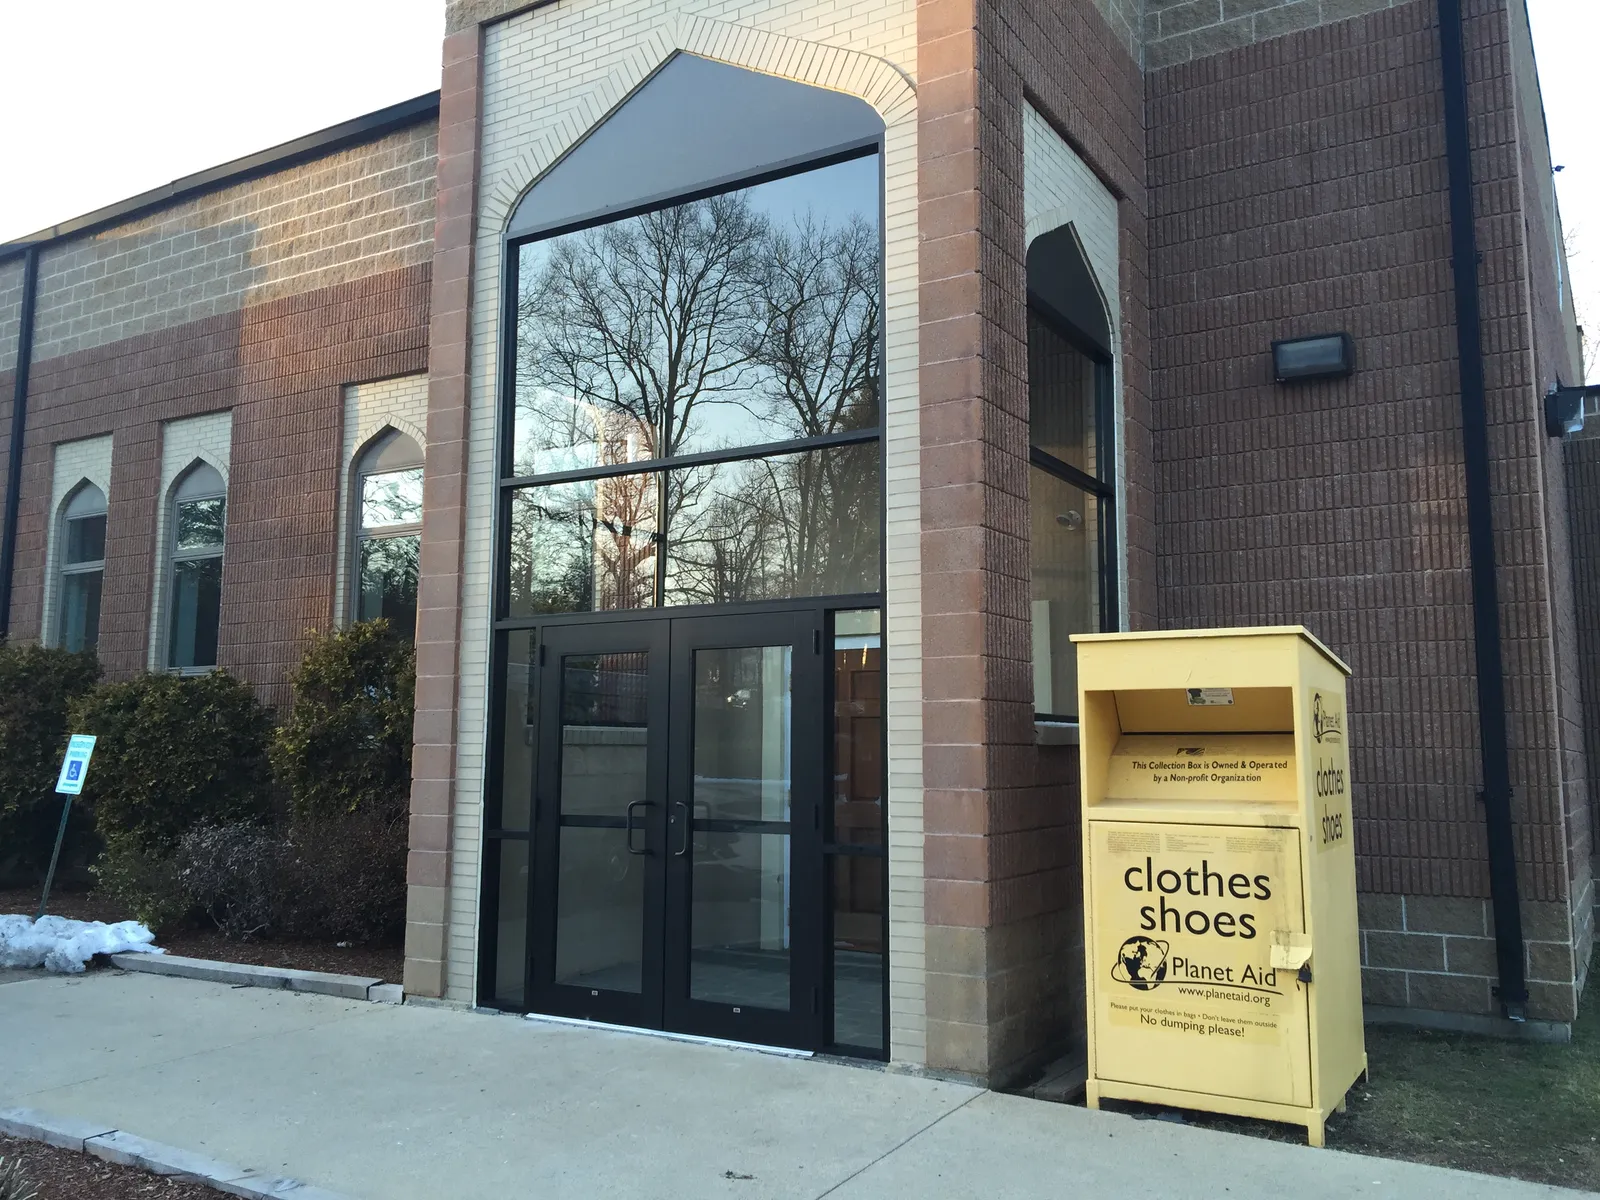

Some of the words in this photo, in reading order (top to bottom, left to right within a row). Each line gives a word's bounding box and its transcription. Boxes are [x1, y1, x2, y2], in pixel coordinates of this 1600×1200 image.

[1132, 761, 1147, 769] This
[1149, 761, 1186, 769] Collection
[1187, 761, 1201, 769] Box
[1203, 761, 1209, 769] is
[1211, 761, 1239, 769] Owned
[1240, 761, 1246, 769] &
[1249, 760, 1288, 770] Operated
[1153, 774, 1162, 783] by
[1170, 773, 1209, 783] Non-profit
[1211, 773, 1262, 783] Organization
[1316, 757, 1344, 797] clothes
[1322, 804, 1343, 844] shoes
[1124, 857, 1272, 901] clothes
[1140, 896, 1257, 940] shoes
[1172, 957, 1234, 983] Planet
[1241, 964, 1277, 987] Aid
[1178, 986, 1271, 1007] www.planetaid.org
[1110, 1002, 1128, 1010] Please
[1129, 1004, 1139, 1012] put
[1140, 1006, 1153, 1014] your
[1155, 1008, 1175, 1016] clothes
[1184, 1011, 1197, 1019] bags
[1202, 1013, 1219, 1022] Don't
[1220, 1016, 1236, 1024] leave
[1237, 1018, 1254, 1026] them
[1255, 1020, 1278, 1029] outside
[1140, 1014, 1157, 1026] No
[1161, 1017, 1206, 1035] dumping
[1208, 1023, 1245, 1038] please!
